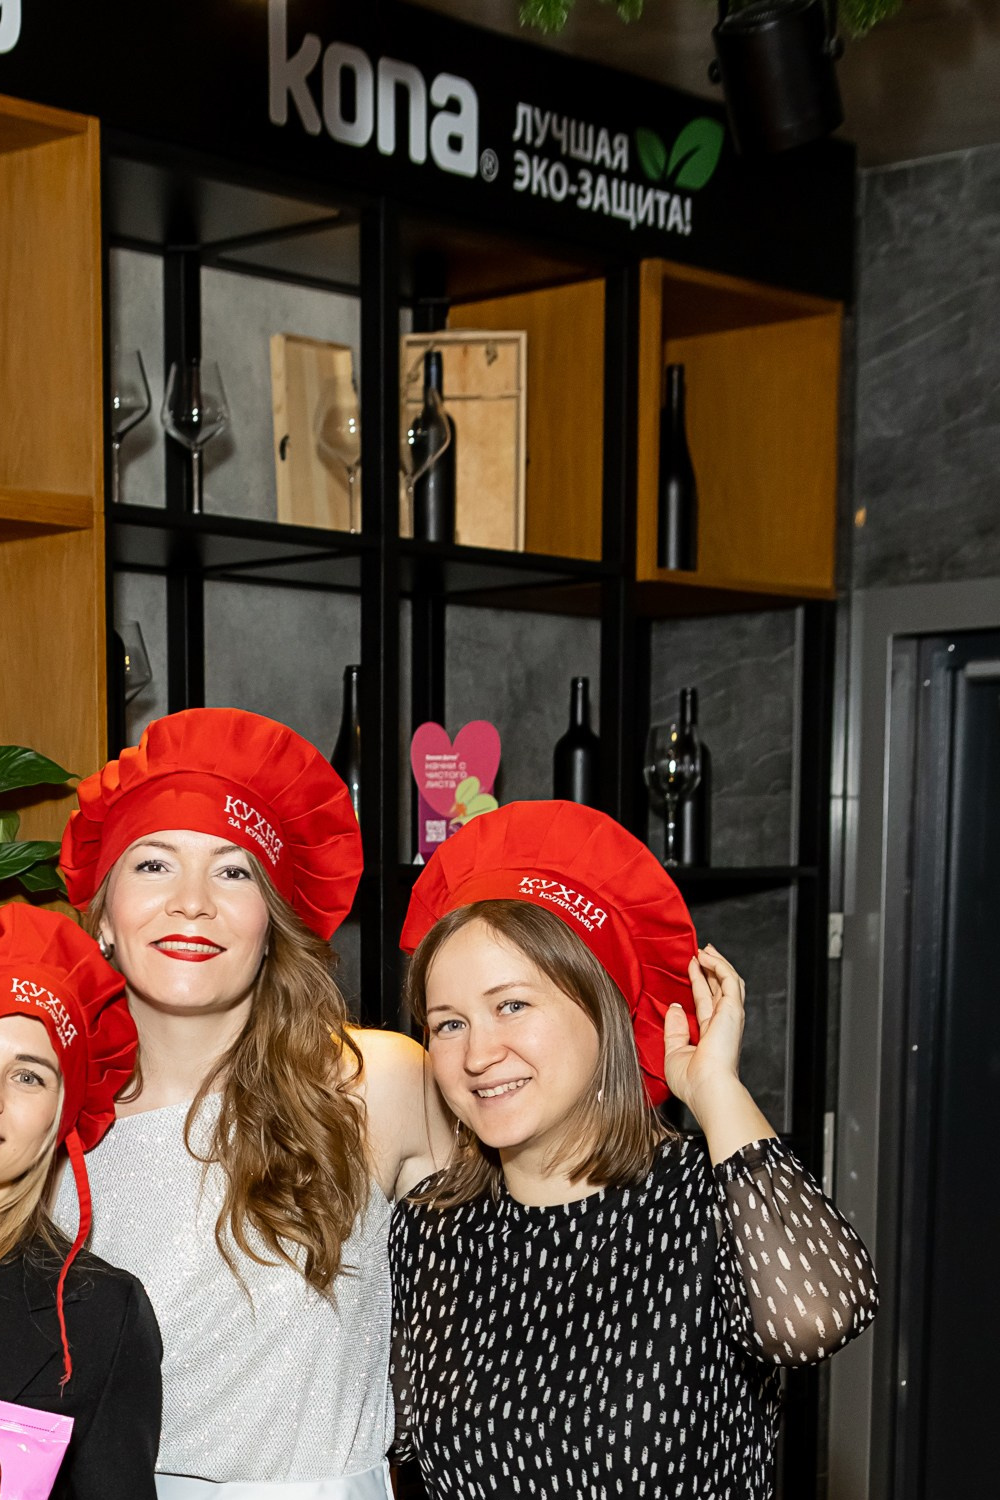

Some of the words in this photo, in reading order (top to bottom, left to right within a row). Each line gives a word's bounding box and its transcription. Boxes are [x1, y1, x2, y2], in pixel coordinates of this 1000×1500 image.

[268, 0, 479, 179] kona
[513, 102, 629, 172] ЛУЧШАЯ
[513, 151, 692, 236] ЭКО-ЗАЩИТА!
[224, 795, 284, 860] КУХНЯ
[519, 877, 608, 929] КУХНЯ
[519, 887, 533, 895] ЗА
[539, 891, 595, 932] КУЛИСАМИ
[10, 978, 78, 1046] КУХНЯ
[15, 994, 31, 1003] ЗА
